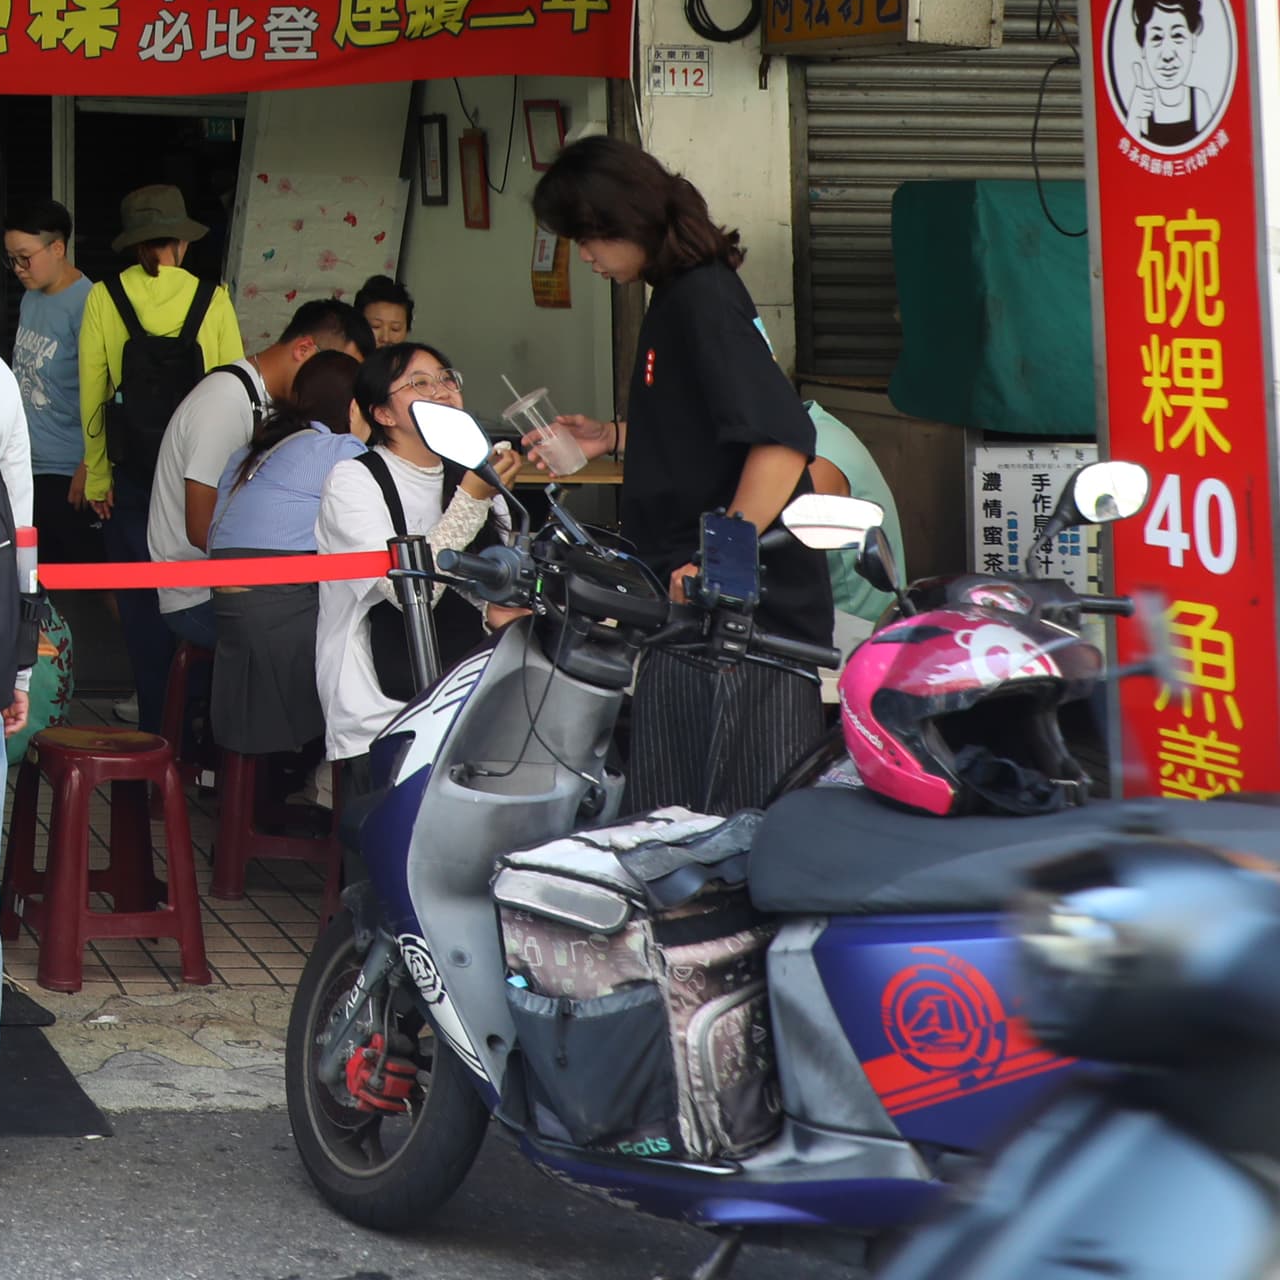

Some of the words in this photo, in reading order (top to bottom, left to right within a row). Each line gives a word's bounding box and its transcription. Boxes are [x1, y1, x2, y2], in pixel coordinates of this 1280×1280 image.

[138, 7, 322, 63] 必比登
[668, 66, 705, 88] 112
[1135, 207, 1232, 458] 碗粿
[981, 471, 1004, 574] 濃情蜜茶
[1143, 473, 1238, 576] 40
[617, 1135, 673, 1156] Eats
